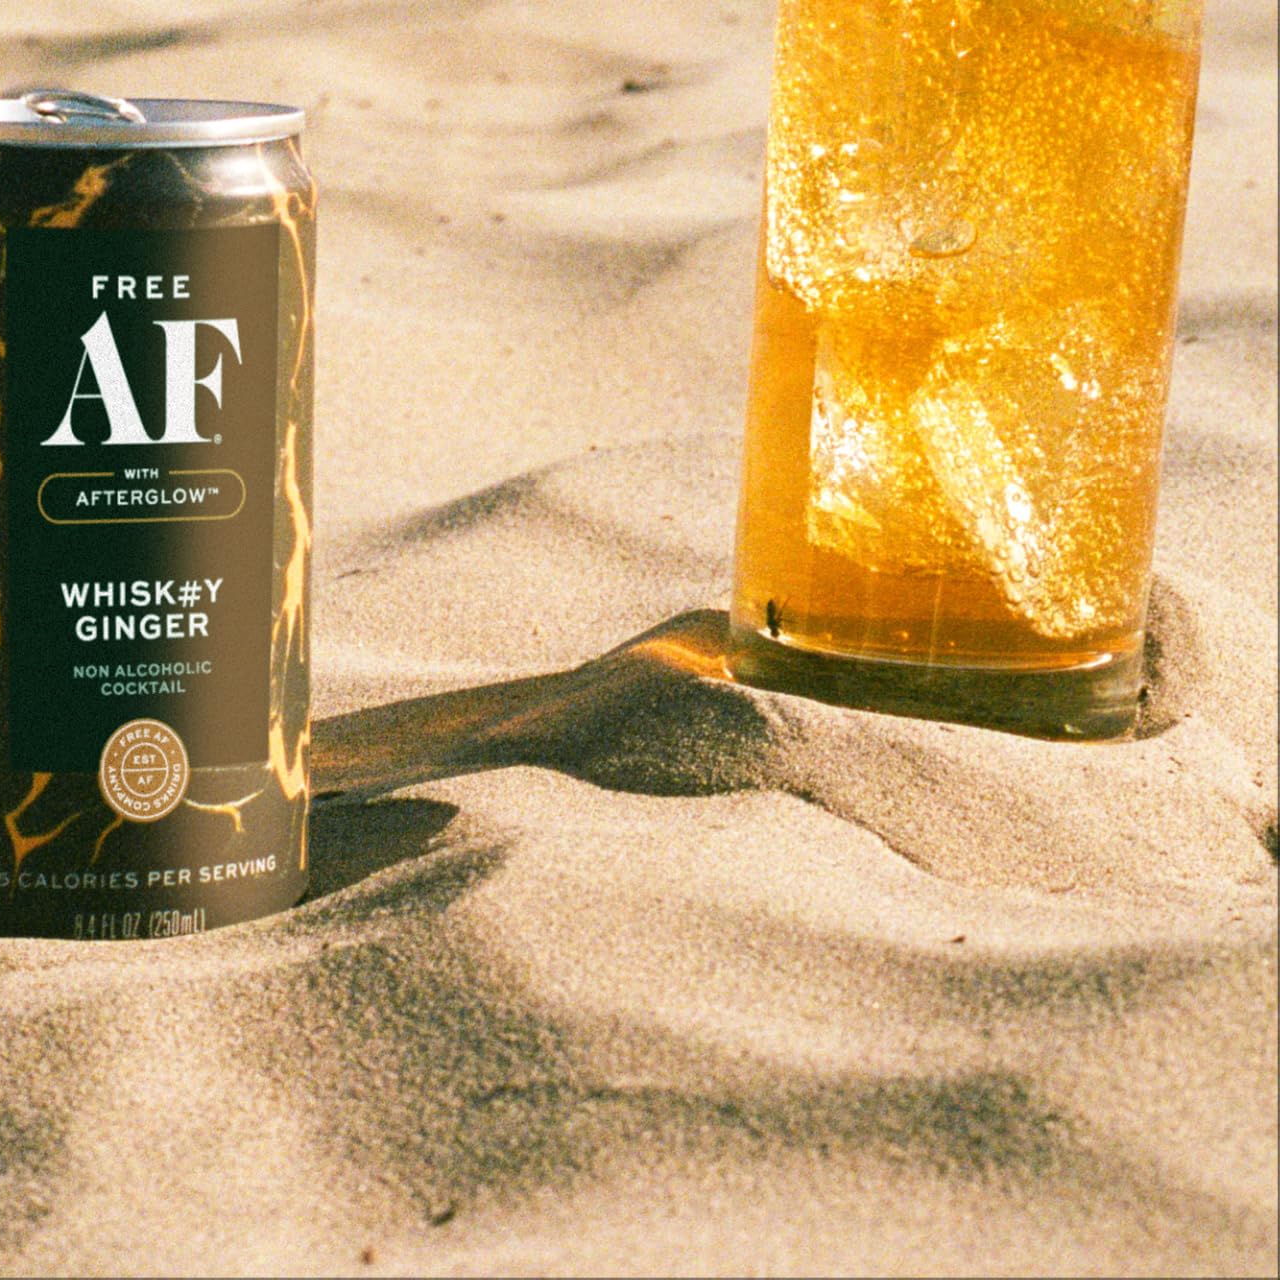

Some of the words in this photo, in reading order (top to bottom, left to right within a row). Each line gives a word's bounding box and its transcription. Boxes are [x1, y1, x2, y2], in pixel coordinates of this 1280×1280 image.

[92, 275, 190, 299] FREE
[124, 468, 159, 480] WITH
[61, 578, 223, 608] WHISK#Y
[75, 613, 209, 642] GINGER
[73, 664, 110, 679] NON
[115, 660, 212, 678] ALCOHOLIC
[101, 680, 186, 696] COCKTAIL
[137, 775, 154, 785] AF
[18, 870, 138, 890] CALORIES
[147, 868, 191, 887] PER
[199, 854, 276, 883] SERVING
[122, 911, 142, 938] OZ
